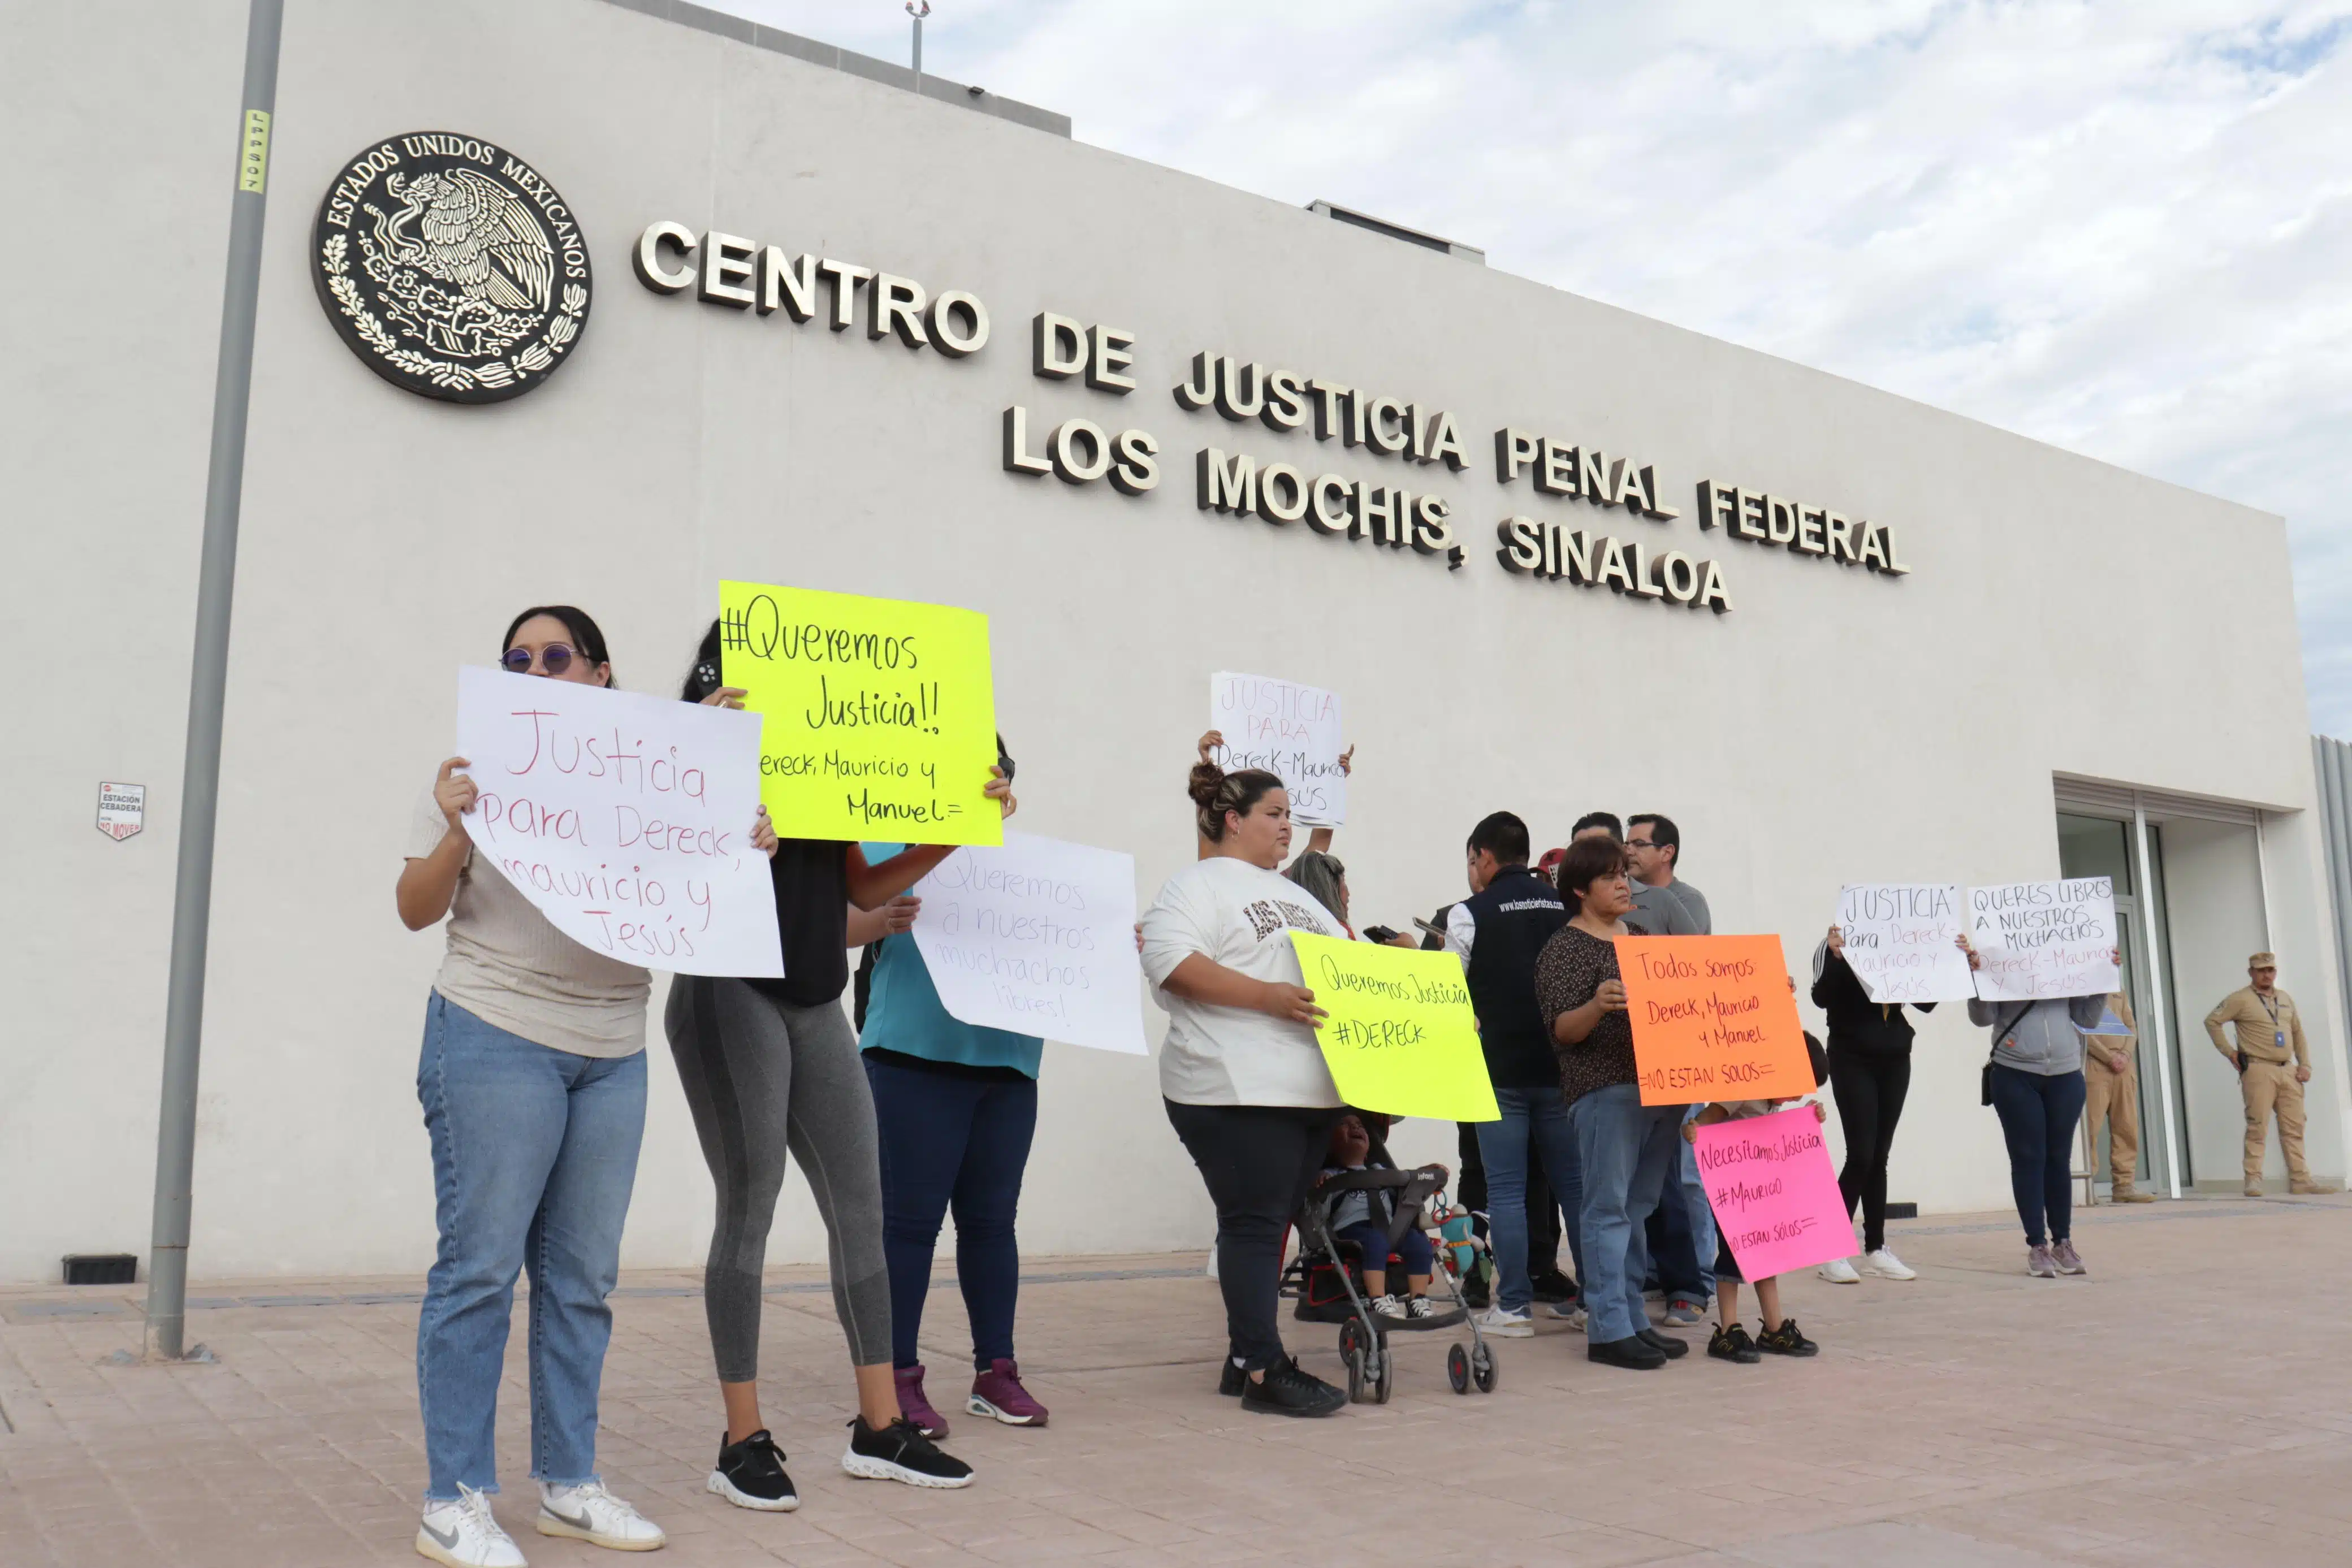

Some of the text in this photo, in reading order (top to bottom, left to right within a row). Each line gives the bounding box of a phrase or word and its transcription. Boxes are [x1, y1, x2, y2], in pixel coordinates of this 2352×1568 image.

[327, 135, 586, 278] ESTADOS UNIDOS MEXICANOS
[633, 220, 1911, 577] CENTRO DE JUSTICIA PENAL FEDERAL
[1003, 406, 1733, 614] LOS MOCHIS, SINALOA
[720, 595, 917, 670] #Queremos
[807, 675, 939, 735] Justicia!!
[1222, 678, 1335, 724] JUSTICIA
[1248, 715, 1310, 744] PARA
[506, 709, 706, 807] Justicia
[758, 750, 935, 789] ereck, Mauricio y
[101, 802, 141, 812] CEBADERA
[688, 880, 711, 932] y
[1499, 898, 1564, 912] www.losnoticieristas.com
[1977, 904, 2090, 930] A NUESTROS
[583, 911, 694, 956] Jesús
[978, 908, 1095, 951] nuestros
[2004, 920, 2104, 951] MUCHACHOS
[935, 943, 1089, 989] muchachos
[1321, 954, 1469, 1006] Queremos Justicia
[1636, 952, 1697, 981] Todos
[1647, 991, 1759, 1026] Dereck, Mauricio
[1714, 1024, 1766, 1048] Manuel
[1670, 1066, 1714, 1088] ESTAN
[1701, 1133, 1822, 1173] Necesitamos Justicia
[1741, 1229, 1770, 1249] ESTAN
